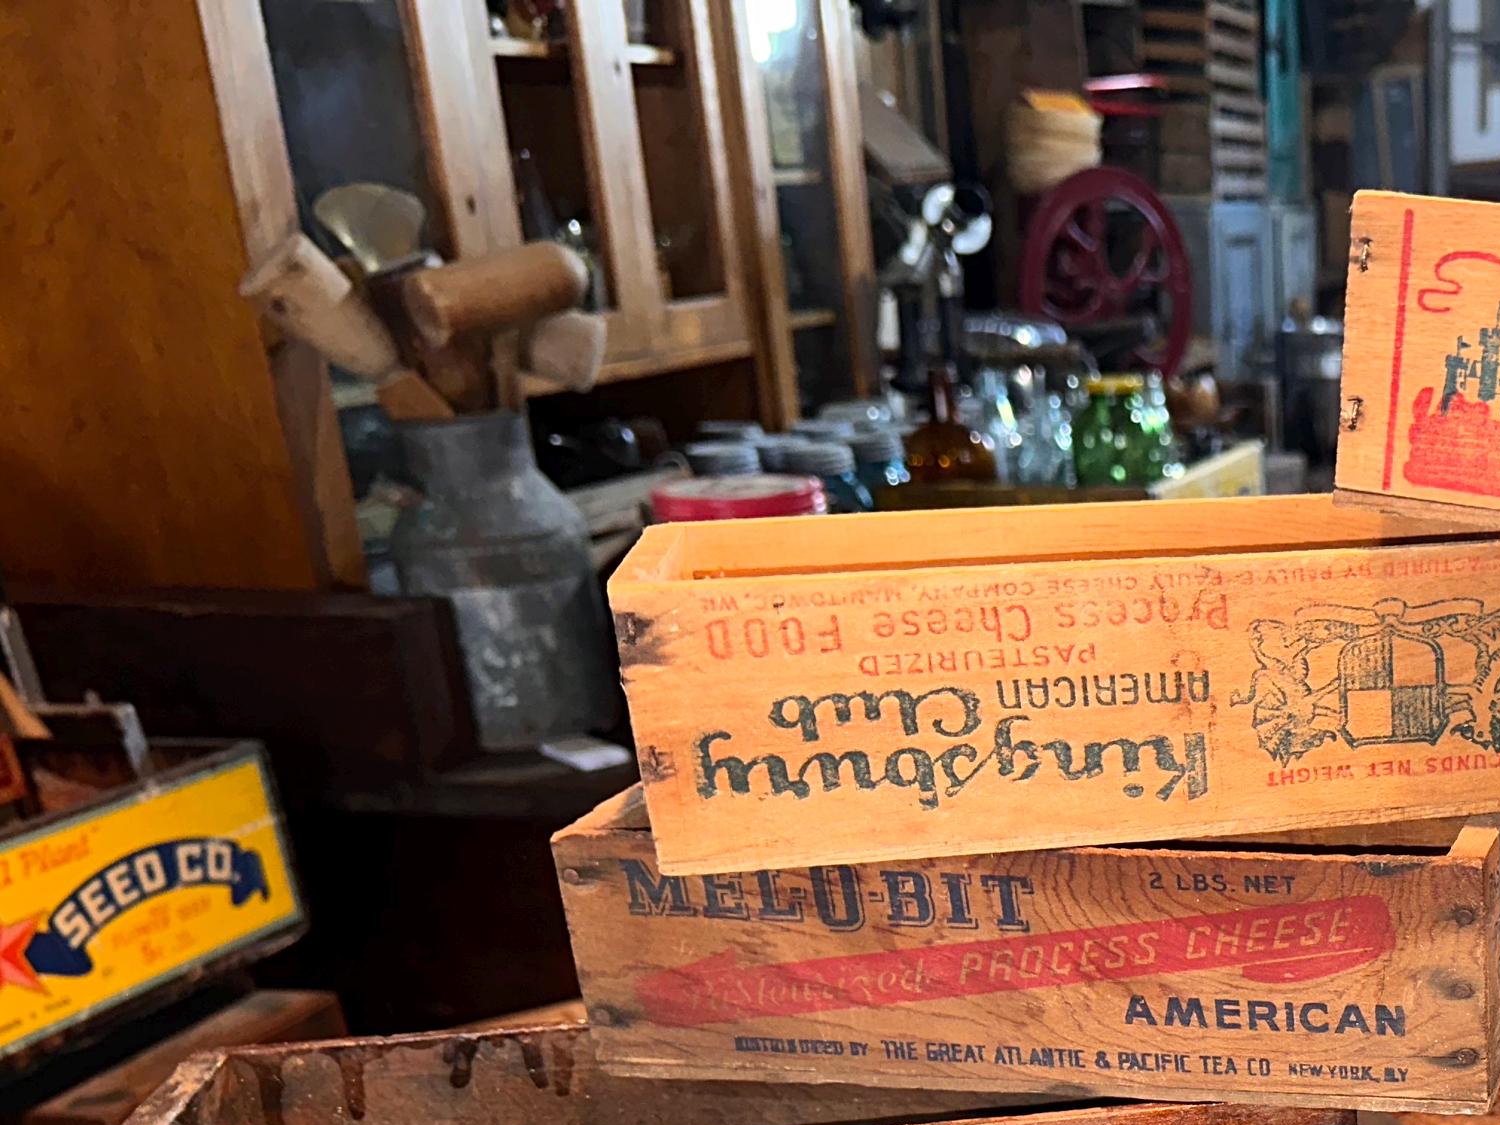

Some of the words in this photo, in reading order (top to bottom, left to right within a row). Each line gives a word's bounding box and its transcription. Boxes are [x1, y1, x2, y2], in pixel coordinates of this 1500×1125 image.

[1048, 575, 1137, 590] CHEESE
[873, 604, 1031, 642] Cheese
[1055, 593, 1229, 631] Process
[705, 615, 842, 660] FOOD
[858, 642, 1096, 676] PASTEURIZED
[997, 670, 1210, 709] AMERICAN
[769, 686, 981, 742] Club
[692, 715, 1209, 810] Kingsbury
[1267, 764, 1351, 787] WEIGHT
[1366, 760, 1413, 777] NET
[52, 850, 166, 951] SEED
[175, 842, 241, 883] CO.
[1150, 872, 1164, 890] 2
[1177, 874, 1236, 893] LBS.
[1243, 876, 1296, 895] NET
[959, 931, 1160, 985] PROCESS
[1186, 904, 1354, 960] CHEESE
[1125, 994, 1407, 1036] AMERICAN
[849, 1042, 868, 1056] BY
[881, 1039, 918, 1061] THE
[926, 1042, 985, 1063] GREAT
[993, 1046, 1086, 1070] ATLANTIC
[1095, 1050, 1110, 1070] &
[1118, 1051, 1191, 1074] PACIFIC
[1199, 1055, 1238, 1075] TEA
[1288, 1063, 1325, 1080] NEW
